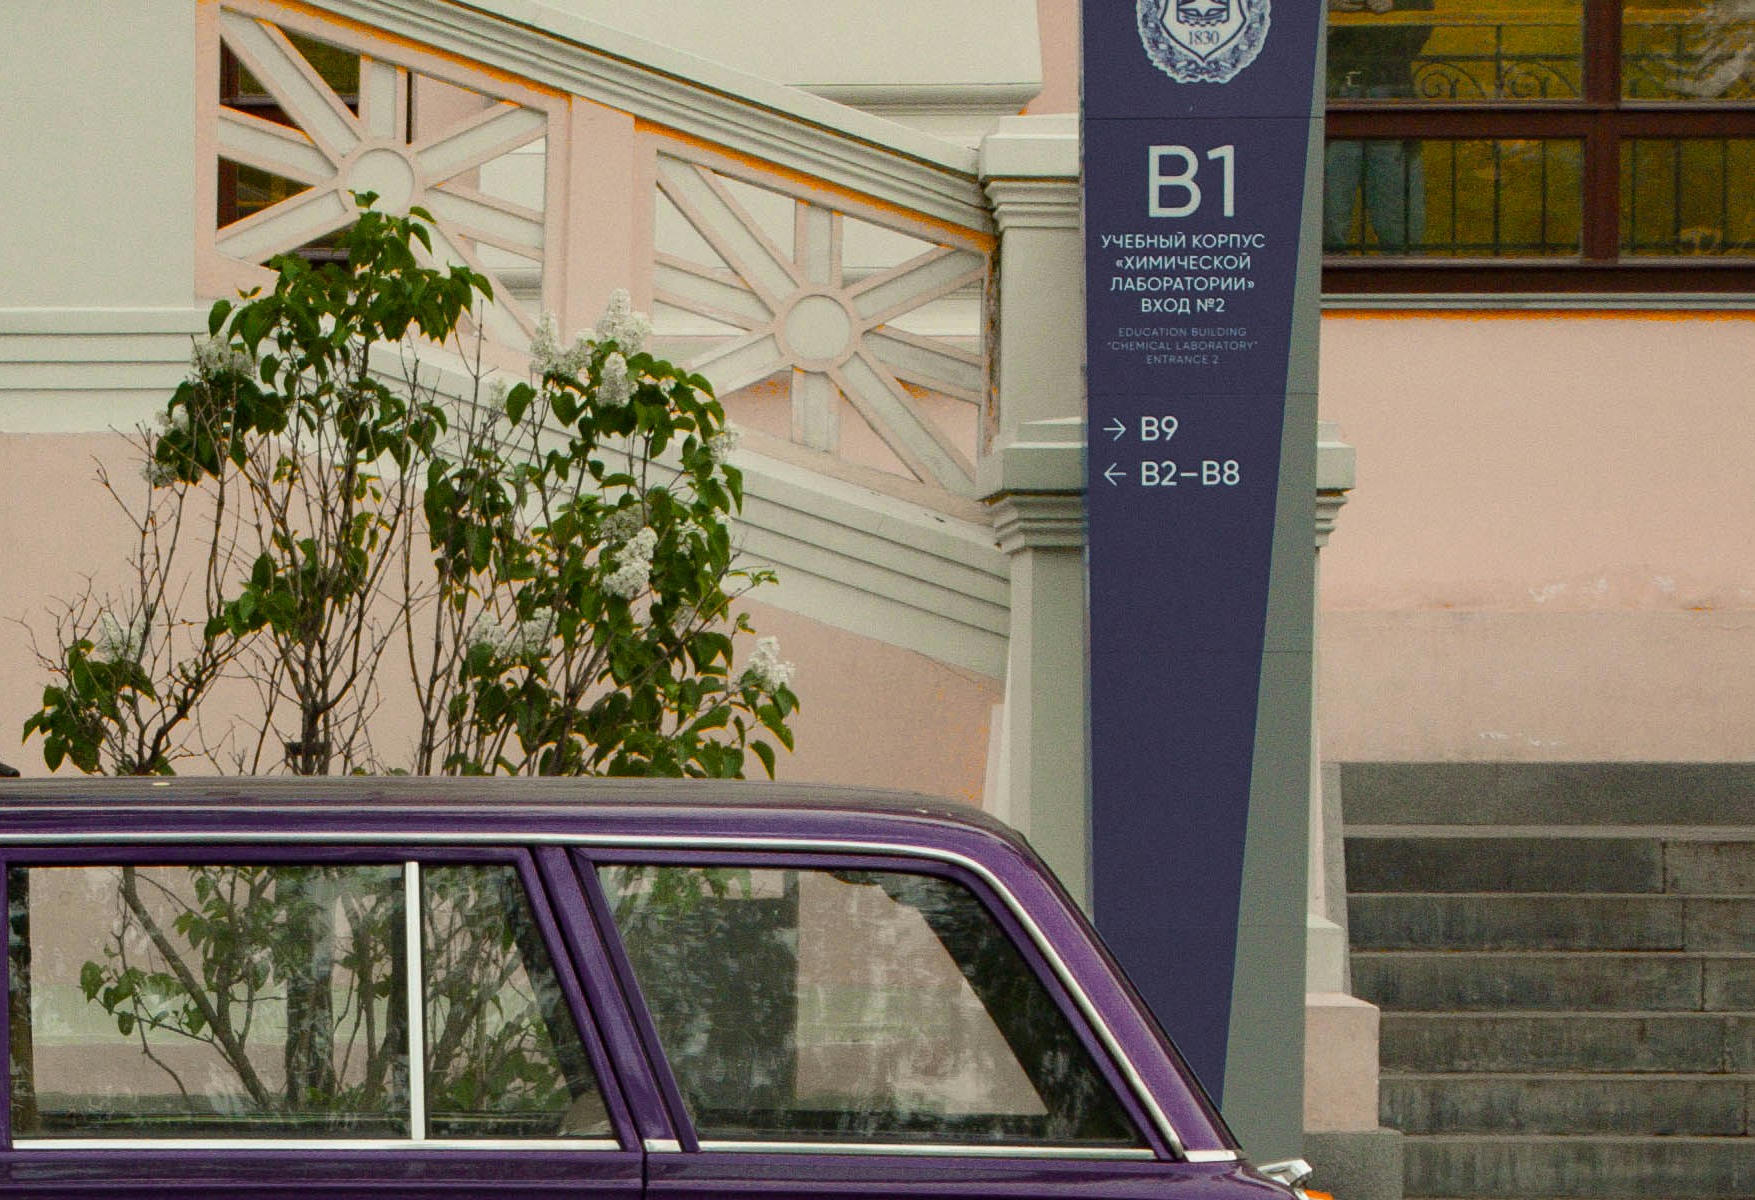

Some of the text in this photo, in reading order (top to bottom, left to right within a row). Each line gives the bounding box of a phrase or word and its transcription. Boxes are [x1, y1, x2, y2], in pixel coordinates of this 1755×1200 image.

[1188, 30, 1220, 45] 1830
[1149, 144, 1235, 217] B1
[1101, 231, 1266, 249] УЧЕБНЫЙ КОРПУС
[1141, 298, 1226, 315] ВХОД №2
[1118, 327, 1247, 337] EDUCATION BUILDING
[1146, 355, 1220, 365] ENTRANCE 2
[1141, 415, 1179, 441] B9
